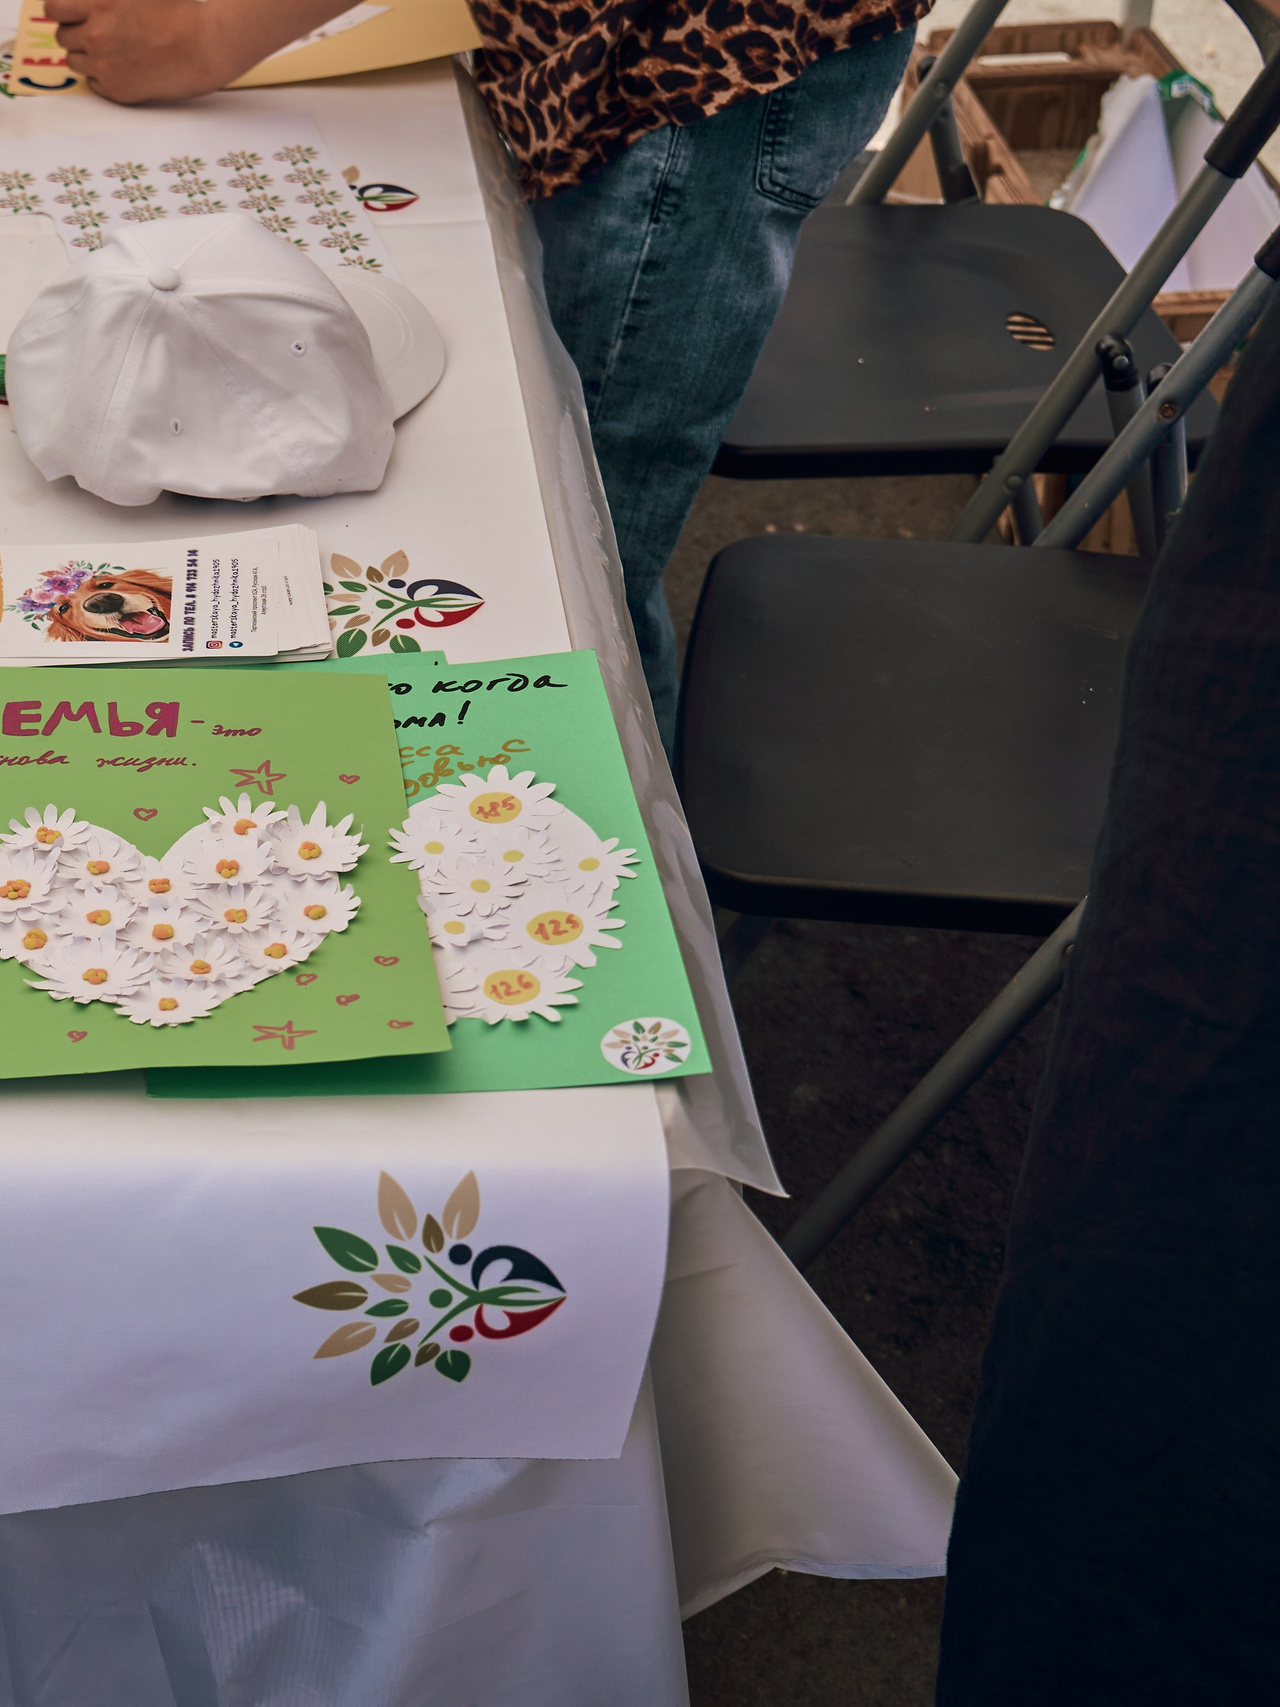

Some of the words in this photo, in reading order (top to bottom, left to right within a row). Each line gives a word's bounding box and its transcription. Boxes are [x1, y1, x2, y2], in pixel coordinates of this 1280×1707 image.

[187, 549, 198, 557] 14
[187, 559, 198, 568] 54
[186, 569, 198, 581] 733
[186, 582, 197, 593] 914
[184, 600, 196, 615] ТЕЛ.
[183, 616, 195, 626] ПО
[182, 627, 195, 652] ЗАПИСЬ
[431, 673, 569, 693] когда
[211, 724, 263, 737] это
[534, 913, 580, 941] 125
[489, 974, 535, 1000] 126
